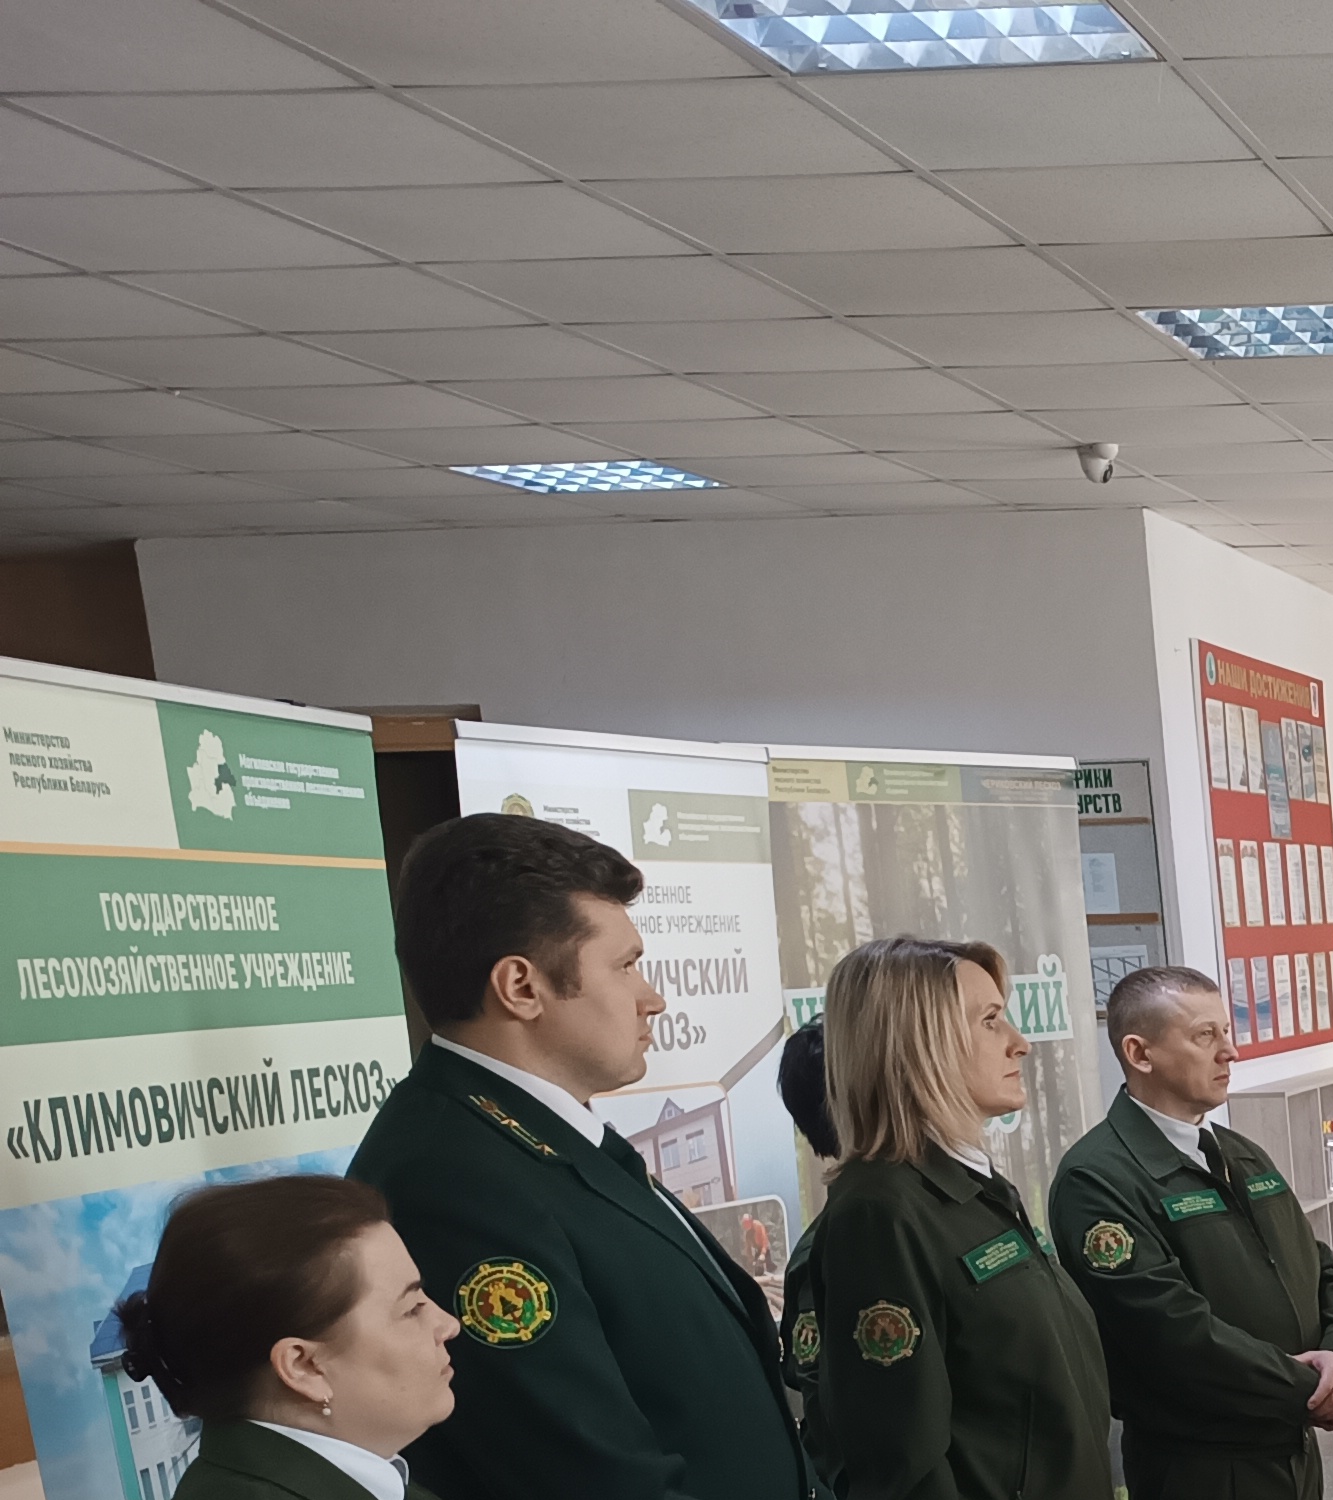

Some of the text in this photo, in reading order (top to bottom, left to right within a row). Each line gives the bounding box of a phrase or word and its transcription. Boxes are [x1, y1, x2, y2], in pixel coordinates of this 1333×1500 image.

[1217, 659, 1311, 709] НАШИ ДОСТИЖЕНИЯ
[3, 726, 71, 749] Министерство
[9, 752, 93, 773] лесного хозяйства
[13, 771, 111, 797] Республики Беларусь
[99, 891, 280, 936] ГОСУДАРСТВЕННОЕ
[666, 915, 742, 935] УЧРЕЖДЕНИЕ
[17, 945, 355, 1000] ЛЕСОХОЗЯЙСТВЕННОЕ УЧРЕЖДЕНИЕ
[638, 947, 749, 997] ИЧСКИЙ
[7, 1057, 286, 1164] «КЛИМОВИЧСКИЙ
